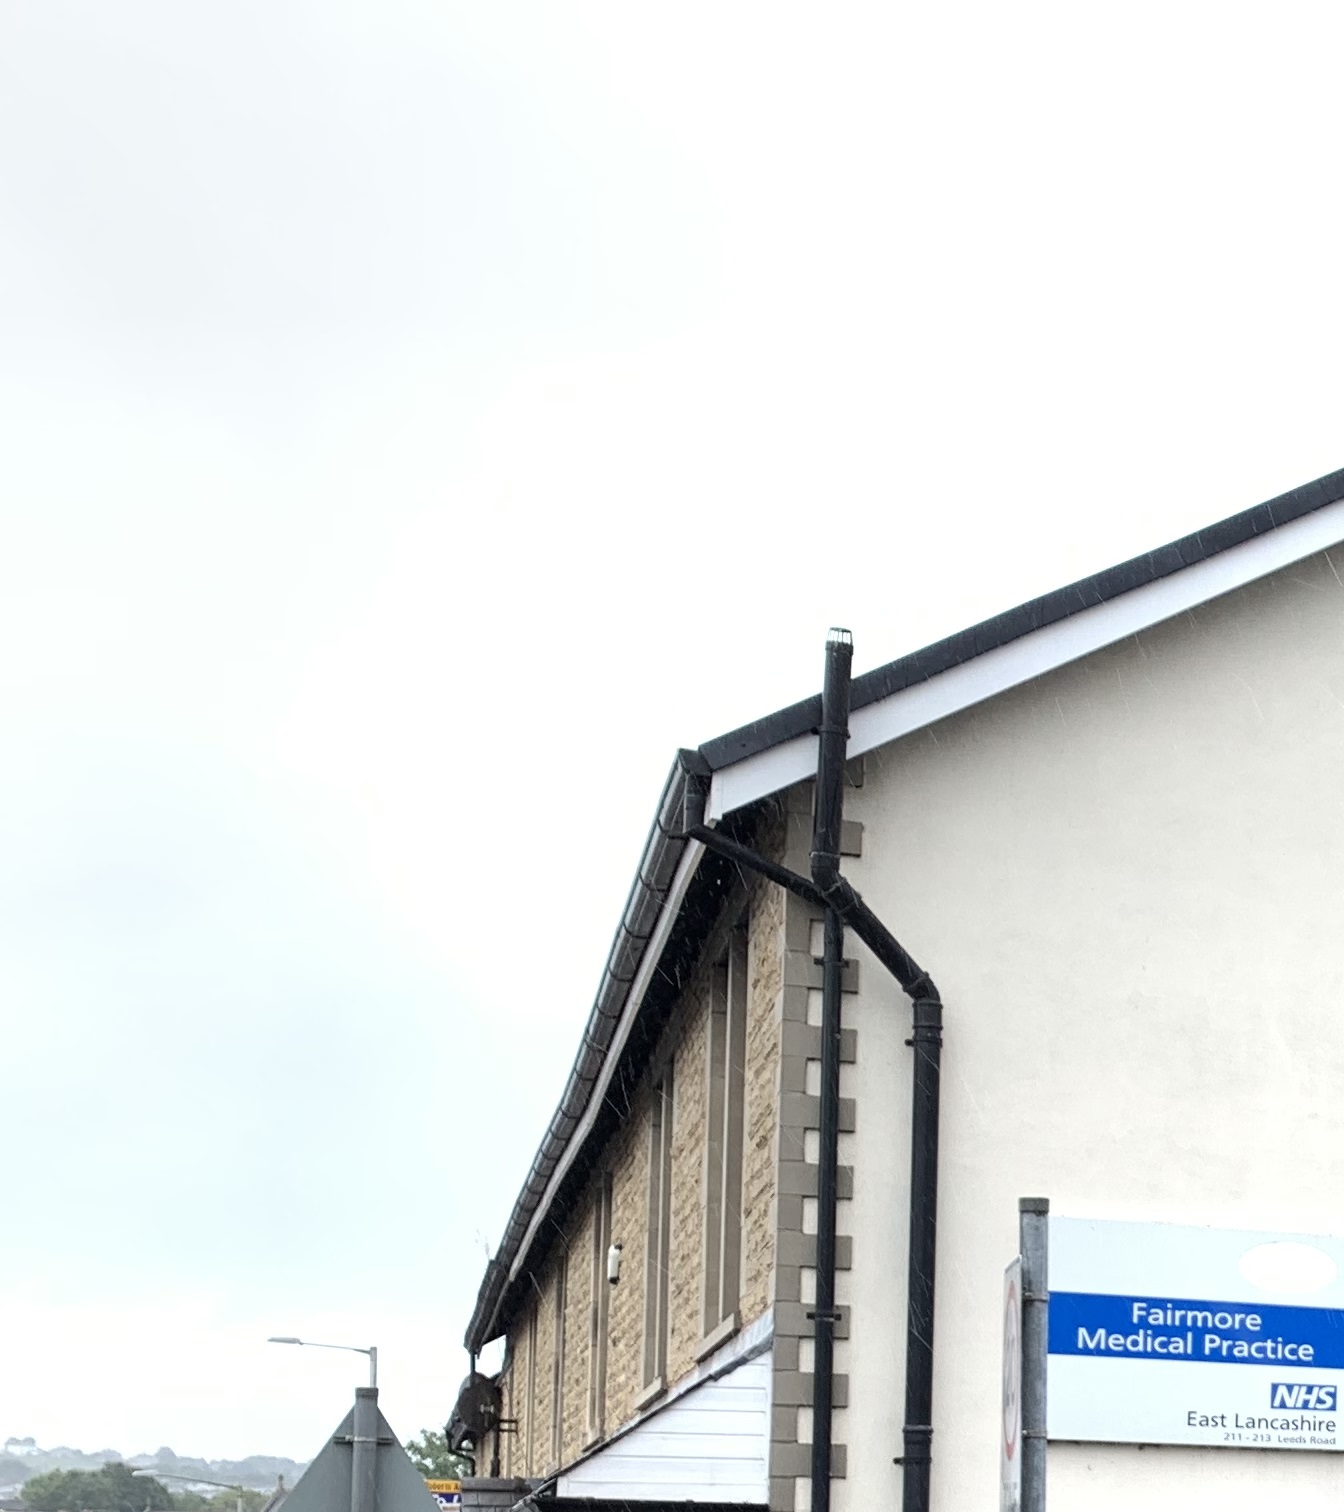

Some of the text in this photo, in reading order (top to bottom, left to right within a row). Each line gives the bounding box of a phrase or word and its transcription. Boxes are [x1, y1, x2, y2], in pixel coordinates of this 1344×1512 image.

[1131, 1302, 1262, 1331] Fairmore
[1077, 1326, 1314, 1361] Medical Practice
[1272, 1384, 1336, 1410] NHS
[1187, 1410, 1336, 1432] East Lancashire
[1223, 1432, 1242, 1442] 211
[1252, 1433, 1272, 1443] 213
[1277, 1435, 1307, 1444] Leeds
[1310, 1436, 1336, 1445] Road
